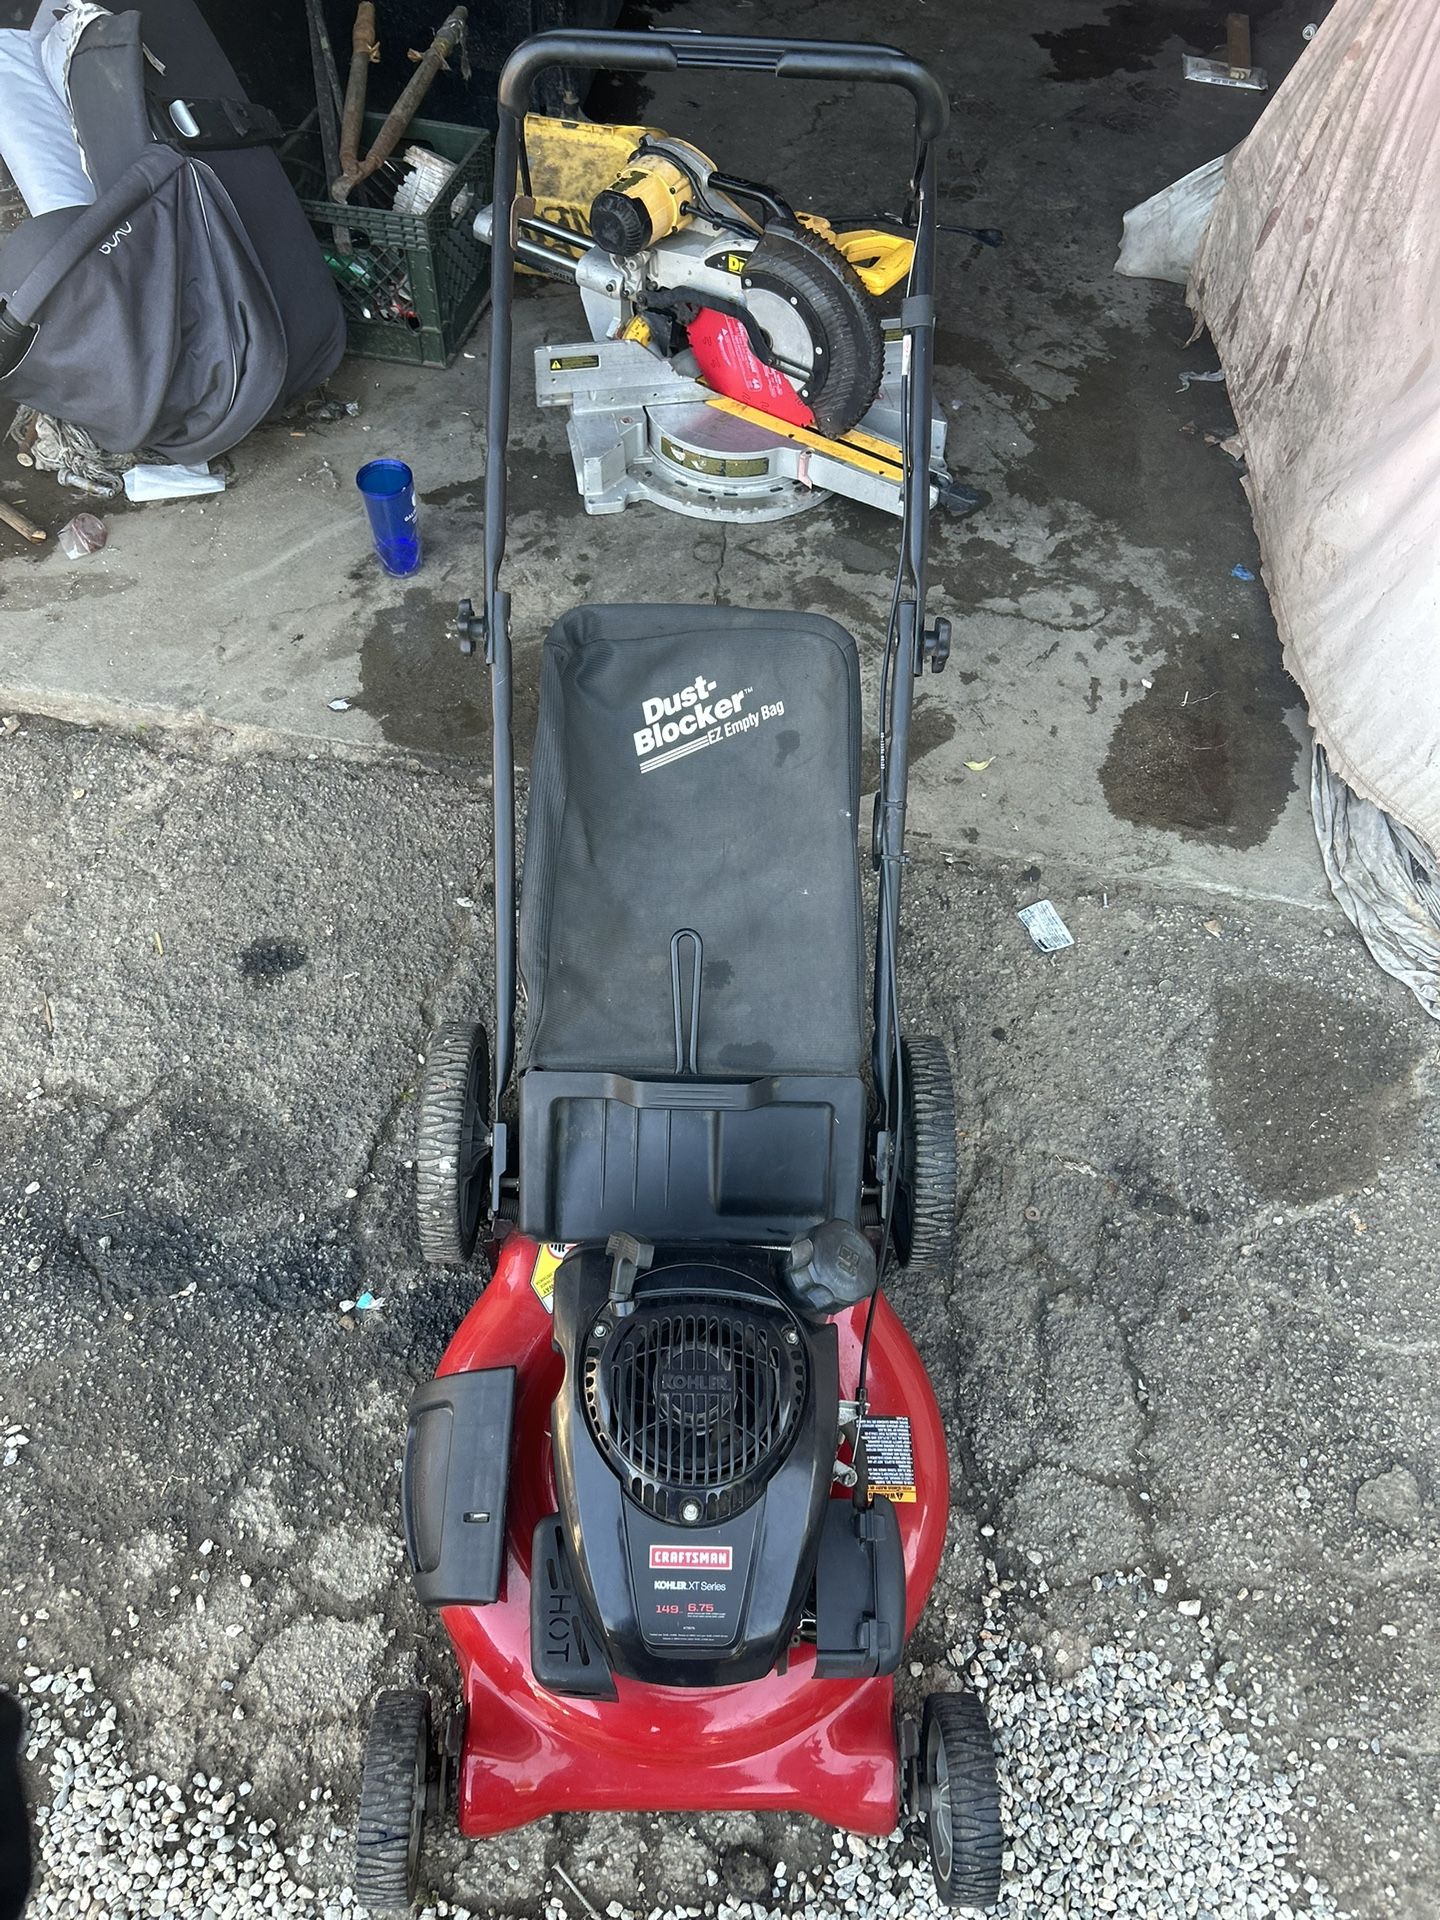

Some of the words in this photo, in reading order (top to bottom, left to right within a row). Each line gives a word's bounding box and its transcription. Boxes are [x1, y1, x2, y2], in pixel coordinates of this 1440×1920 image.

[642, 675, 717, 725] Dust-
[707, 727, 723, 745] EZ
[725, 711, 759, 737] Empty
[761, 699, 784, 721] Bag
[655, 1551, 726, 1564] CRAFTSMAN
[701, 1581, 726, 1591] Series
[656, 1605, 679, 1613] 149
[688, 1603, 714, 1612] 6.75
[547, 1595, 571, 1662] HOT
